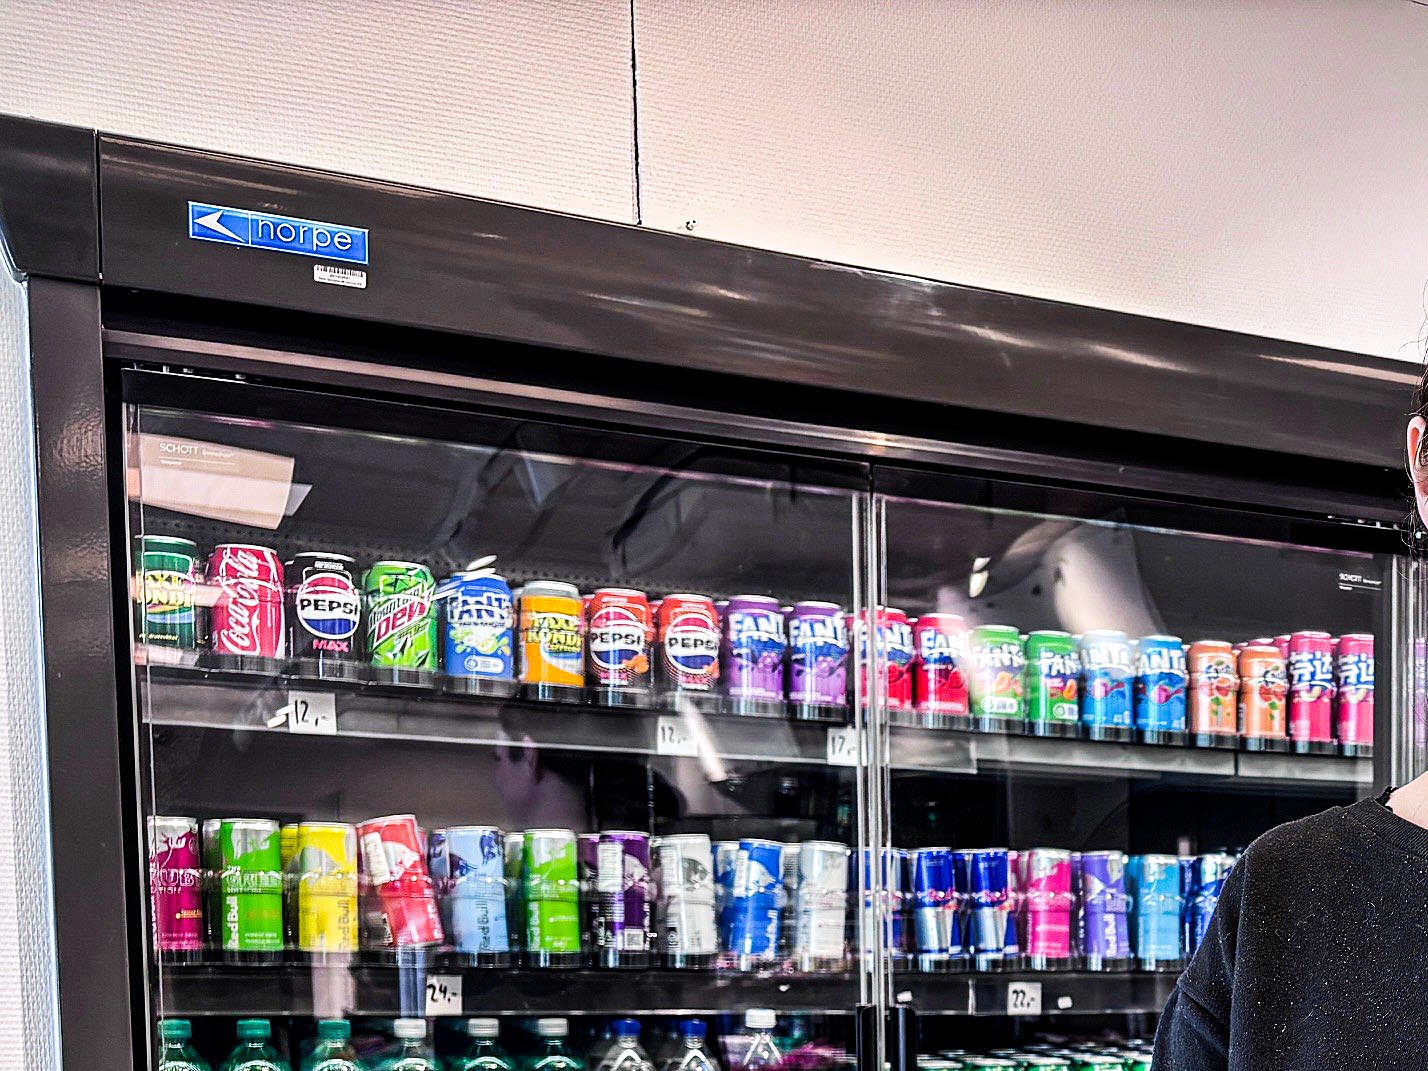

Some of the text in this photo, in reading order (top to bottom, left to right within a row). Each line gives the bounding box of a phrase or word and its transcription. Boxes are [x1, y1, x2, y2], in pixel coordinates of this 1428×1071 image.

[258, 218, 352, 252] norpe
[159, 443, 199, 455] SCHOTT
[299, 598, 358, 616] PEPSI
[312, 639, 349, 653] MAX
[590, 632, 642, 646] PEPSI
[425, 983, 459, 1003] 24,-
